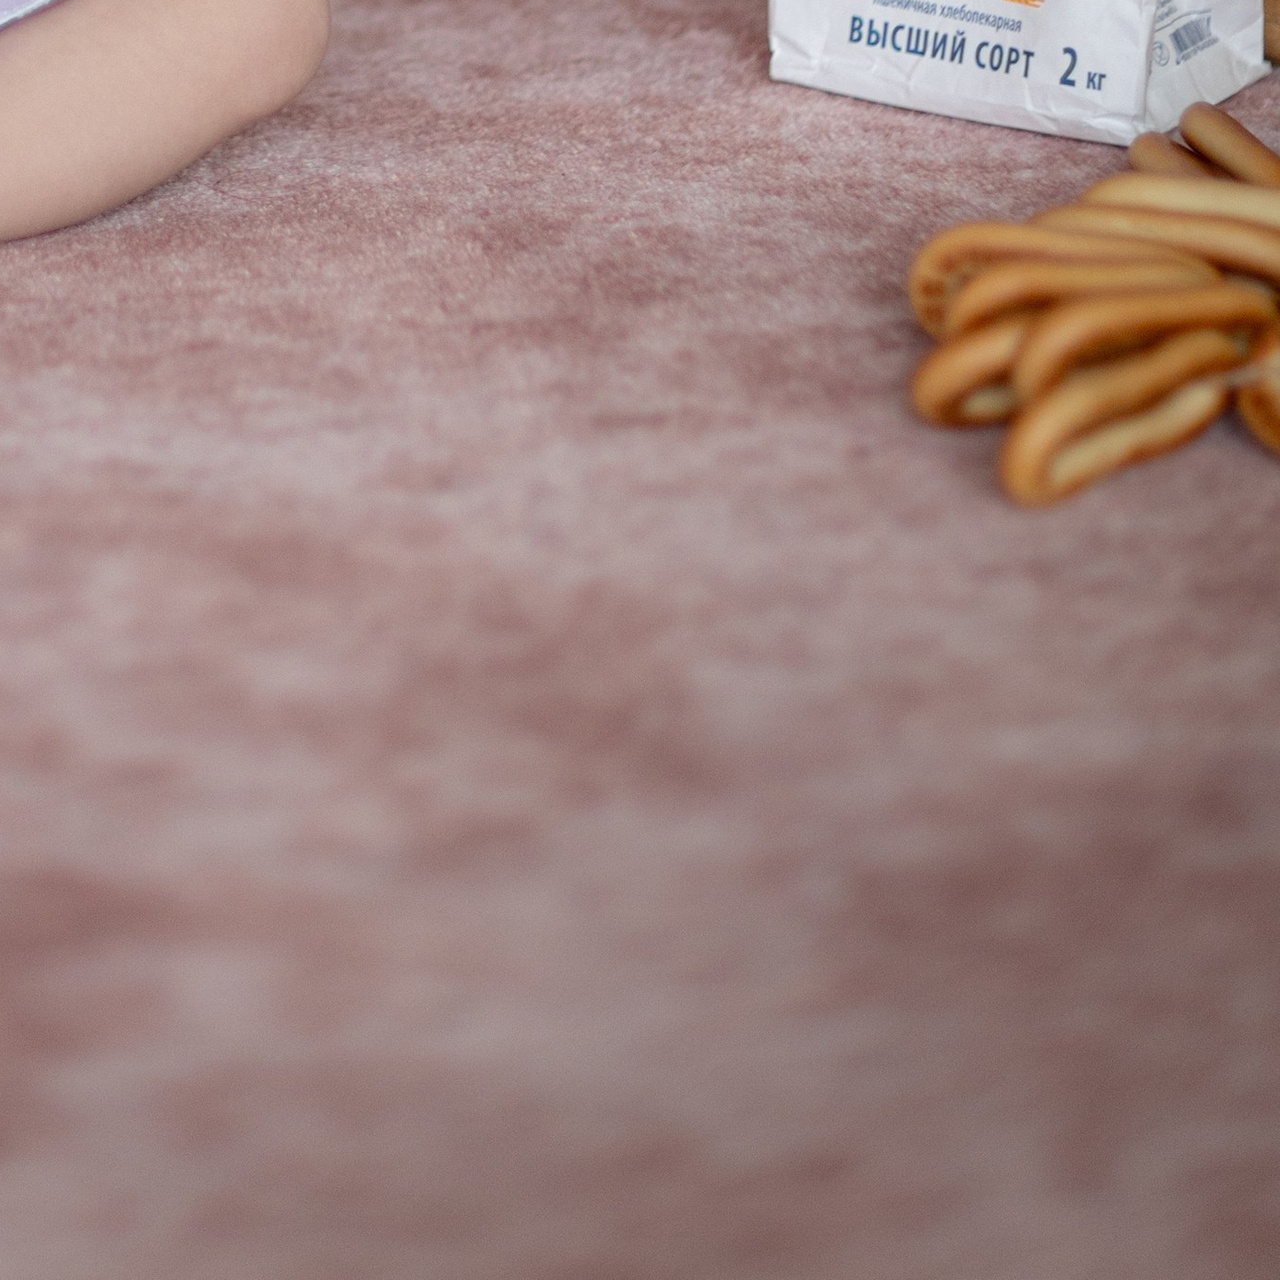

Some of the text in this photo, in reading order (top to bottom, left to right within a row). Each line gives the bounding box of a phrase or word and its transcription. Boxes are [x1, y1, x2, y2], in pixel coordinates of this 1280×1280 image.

[939, 4, 1023, 33] хлебопекарная
[848, 15, 967, 64] ВЫСШИЙ
[975, 41, 1035, 78] СОРТ
[1059, 47, 1078, 87] 2
